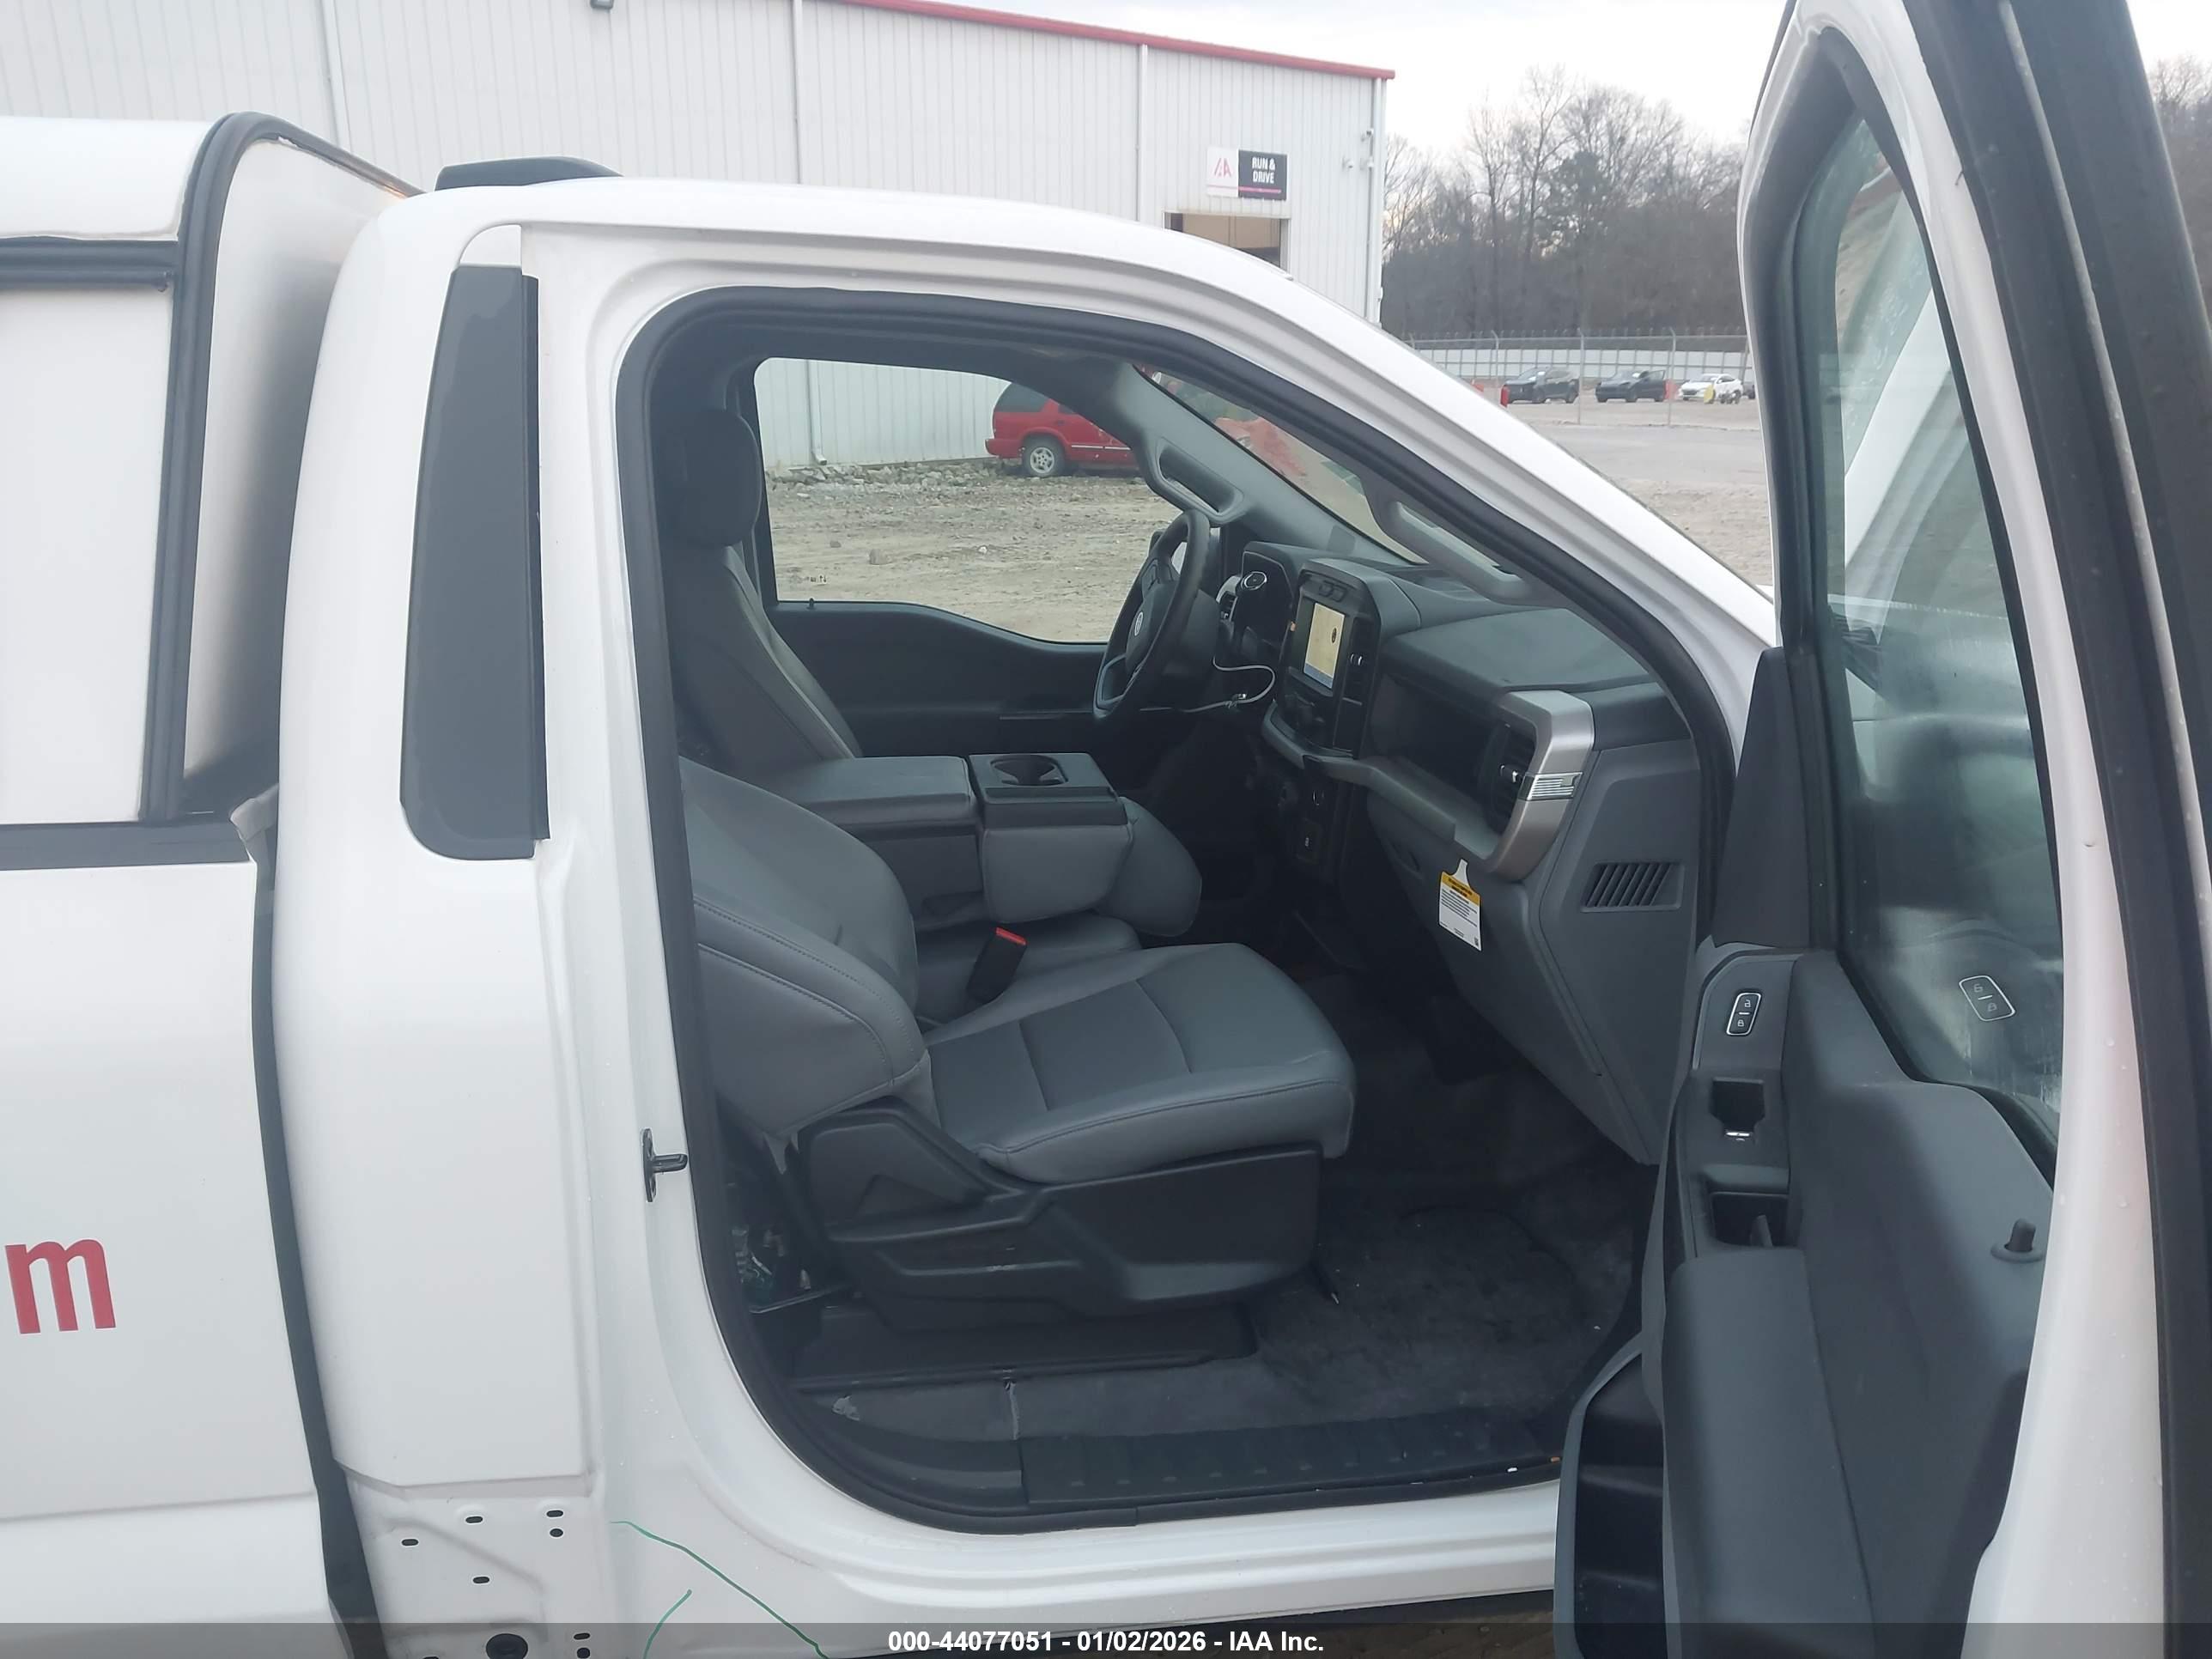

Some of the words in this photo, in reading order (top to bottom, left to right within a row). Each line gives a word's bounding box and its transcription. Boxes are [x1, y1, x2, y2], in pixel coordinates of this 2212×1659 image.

[1252, 157, 1268, 170] RUN
[1269, 158, 1276, 171] &
[1253, 170, 1274, 184] DRIVE
[5, 1239, 116, 1334] m
